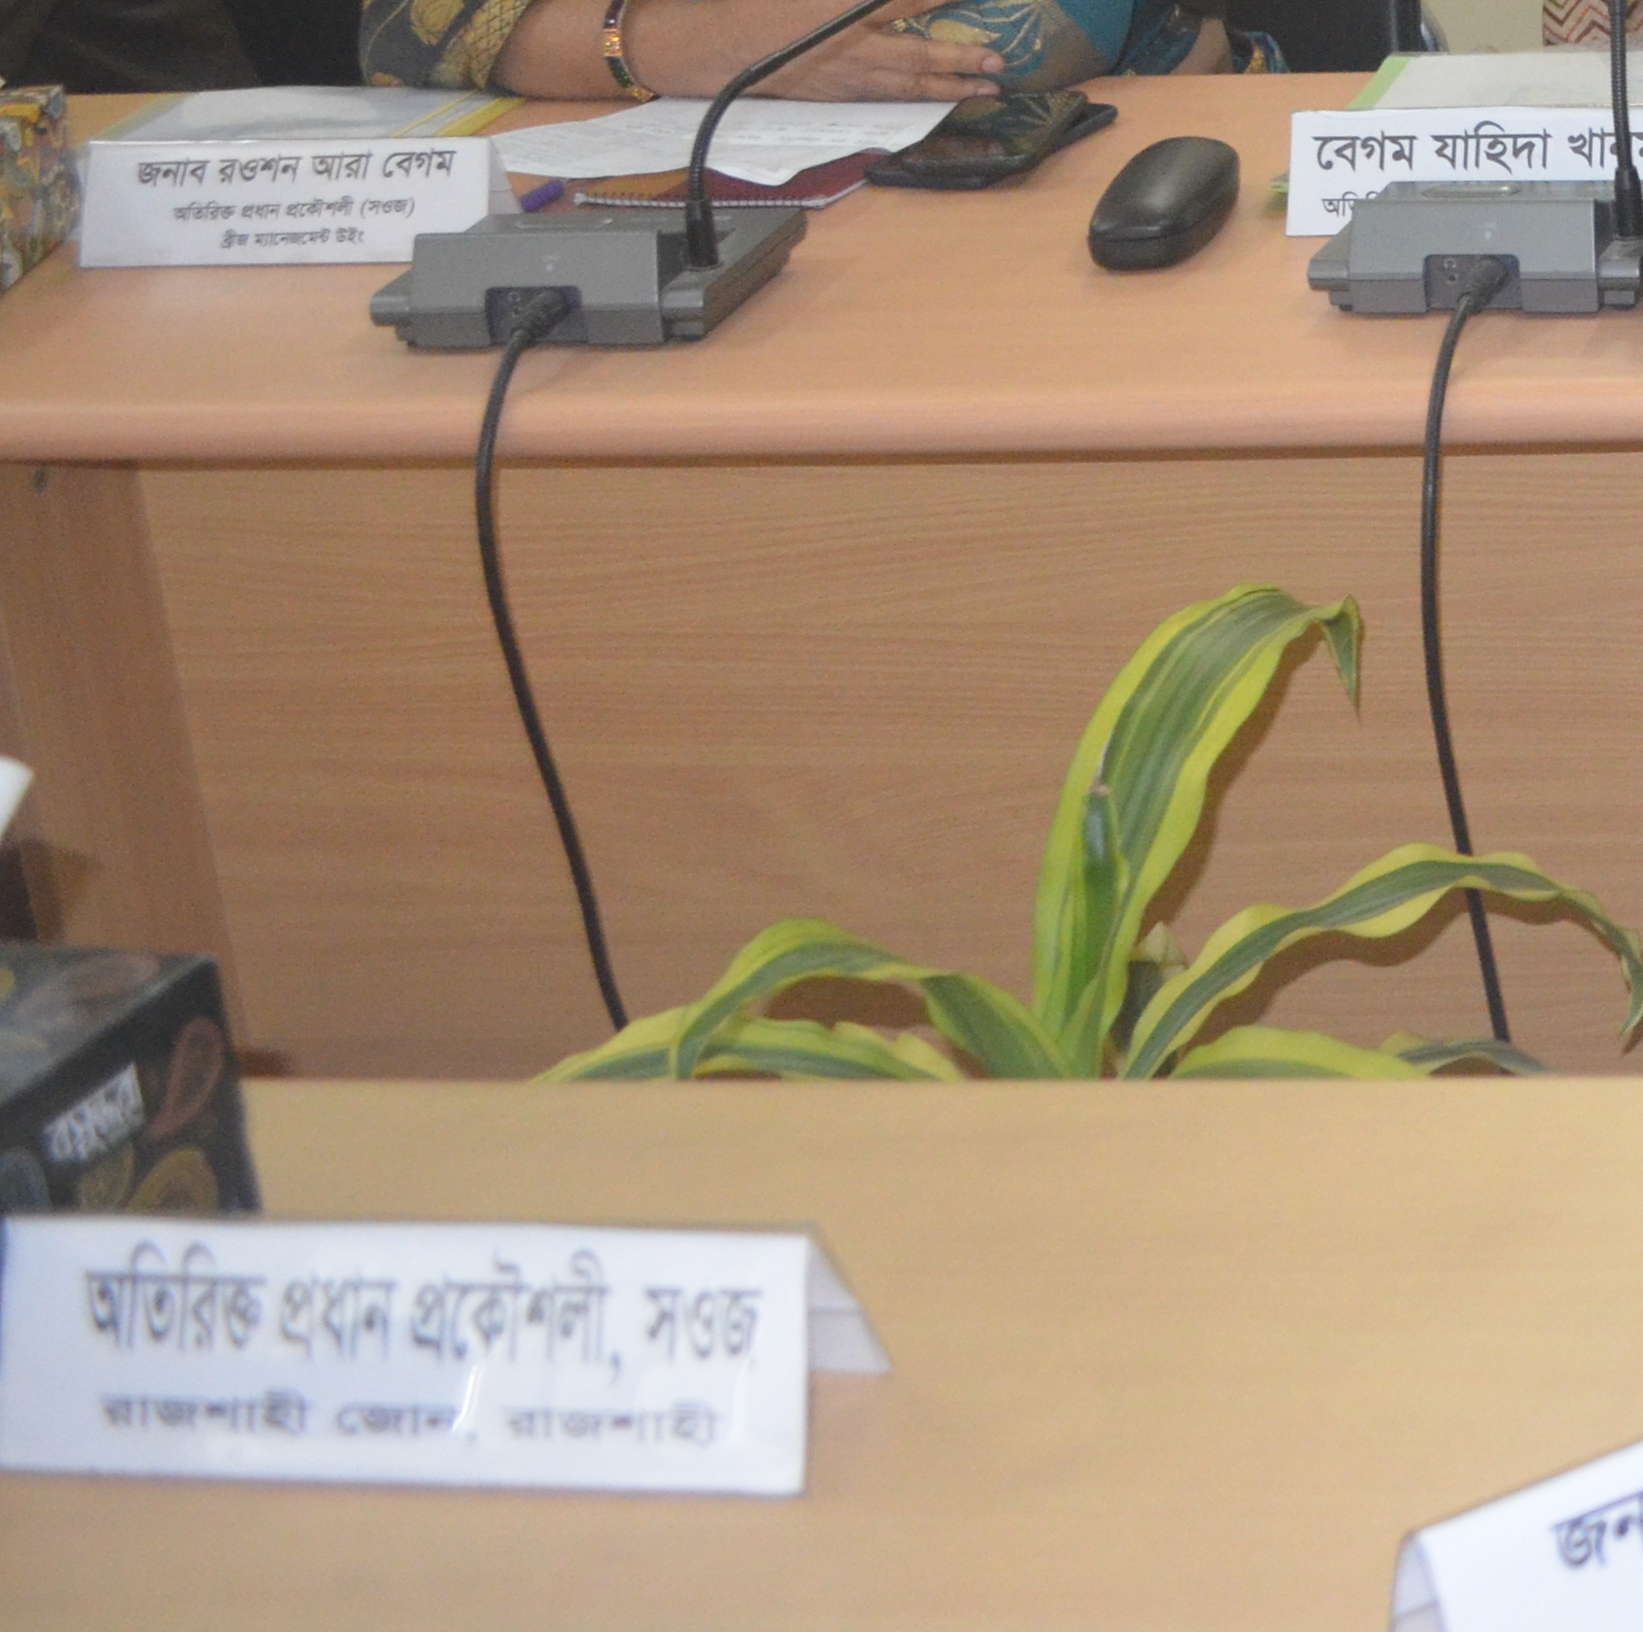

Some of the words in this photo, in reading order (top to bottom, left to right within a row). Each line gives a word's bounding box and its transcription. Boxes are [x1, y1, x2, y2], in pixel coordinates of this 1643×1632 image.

[138, 158, 210, 188] জনাব
[219, 154, 301, 185] রওশন
[312, 151, 373, 183] আরা
[383, 149, 457, 177] বেগম
[1311, 129, 1418, 170] বেগম
[1430, 120, 1552, 174] যাহিদা
[174, 200, 236, 221] অতিরিক্ত
[241, 200, 280, 220] প্রধান
[286, 195, 354, 219] প্রকৌশলী
[360, 196, 415, 218] (সওজ)
[85, 1242, 267, 1350] অতিরিক্ত
[279, 1274, 397, 1359] প্রধান
[645, 1285, 764, 1362] সওজ
[102, 1388, 309, 1438] রাজশাহী
[507, 1402, 722, 1446] রাজশাহী
